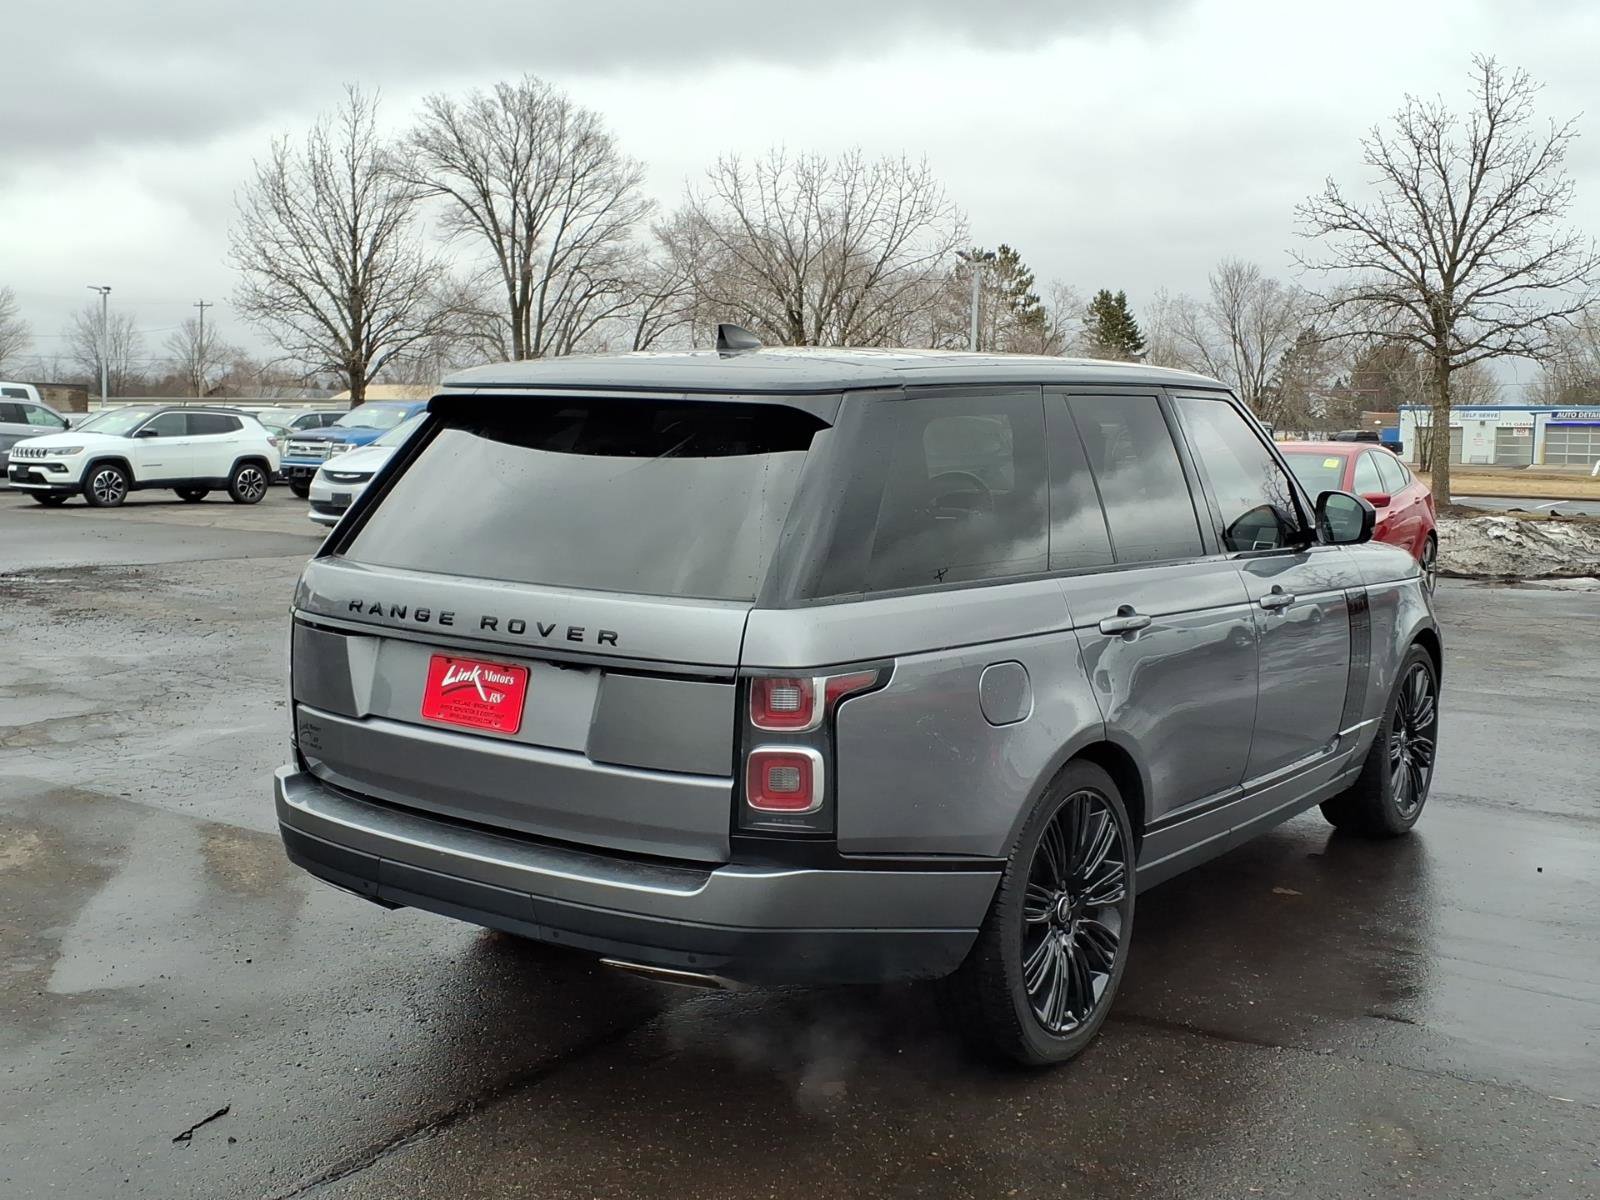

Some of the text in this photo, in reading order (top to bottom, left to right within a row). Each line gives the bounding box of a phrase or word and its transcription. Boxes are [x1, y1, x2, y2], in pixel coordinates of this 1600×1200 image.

[348, 600, 619, 647] RANGE ROVER
[441, 664, 515, 702] Link Motors
[488, 692, 506, 704] RV
